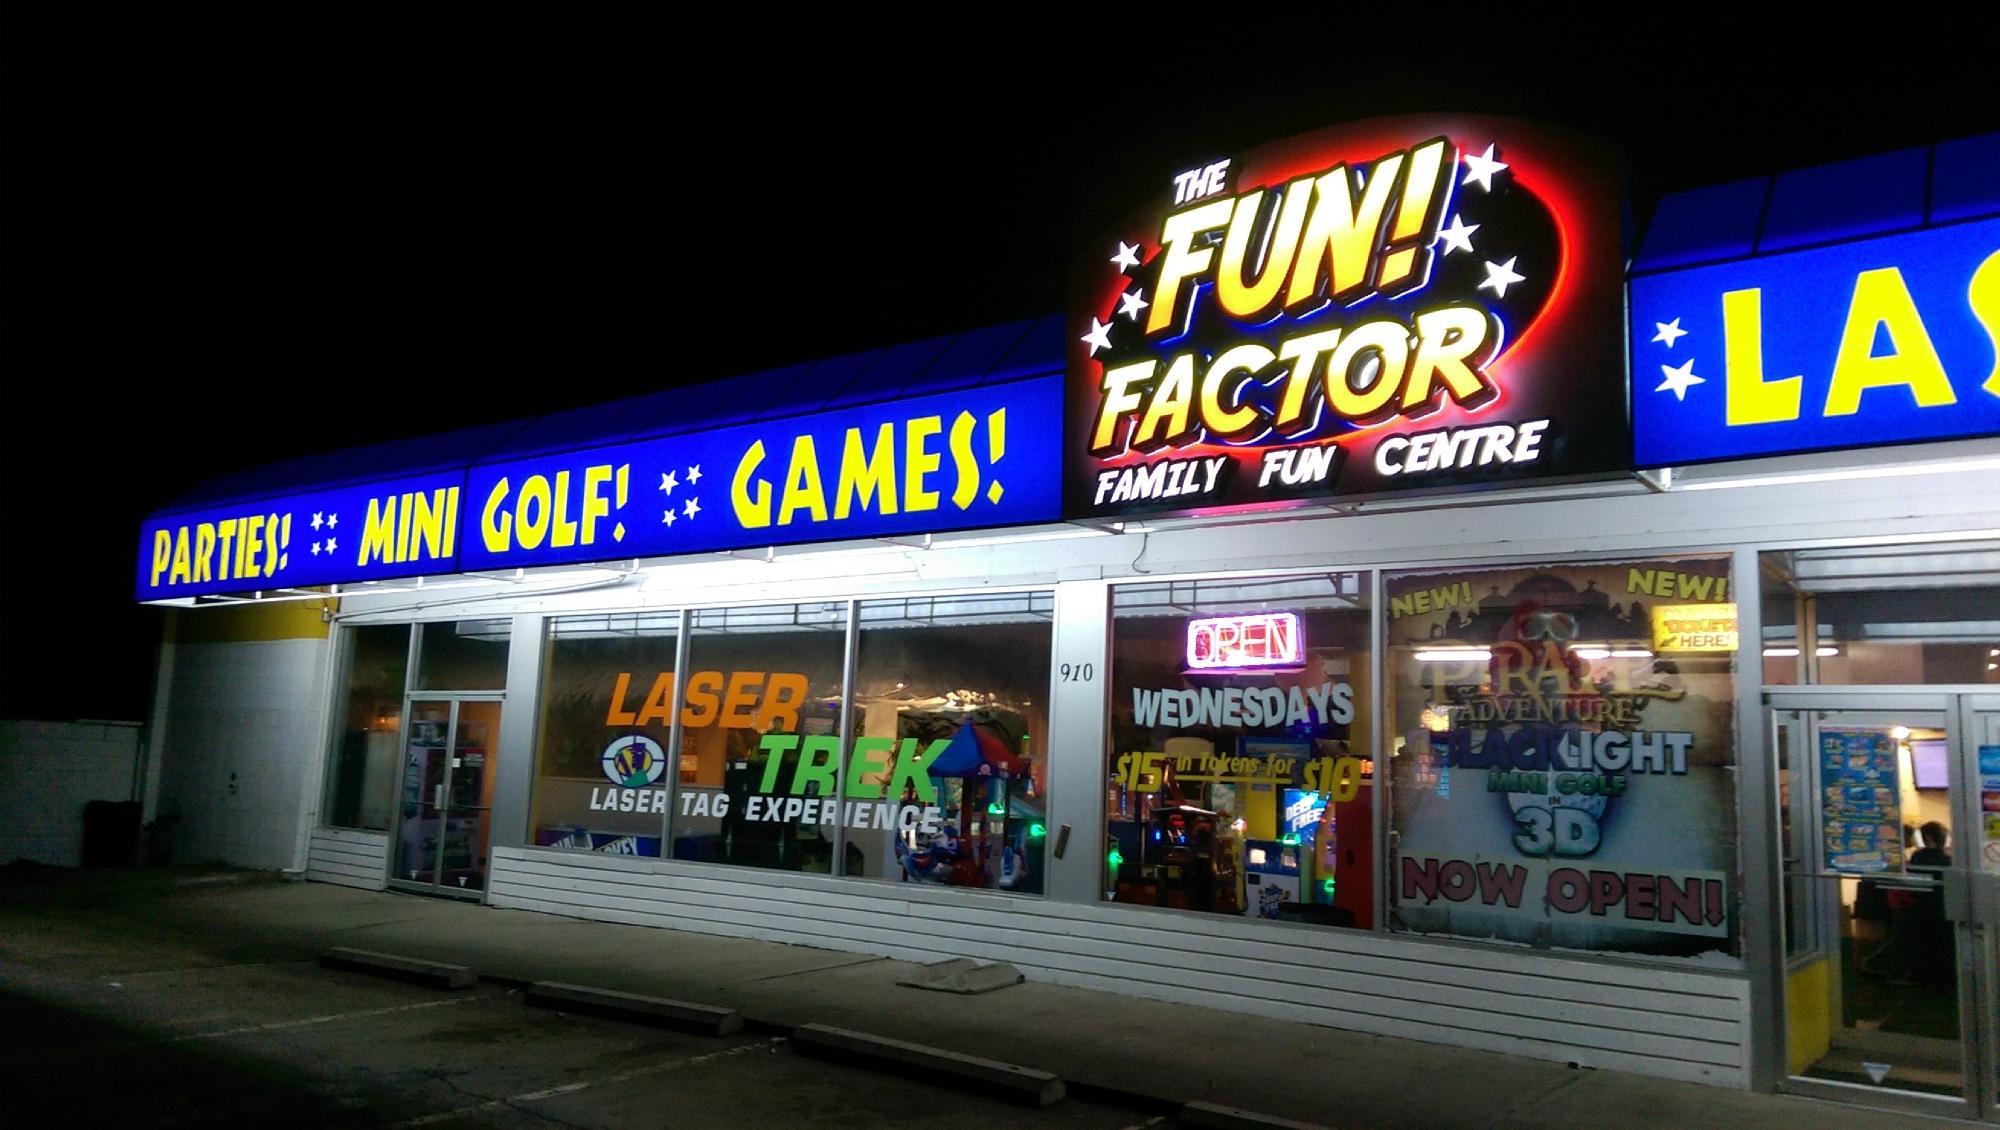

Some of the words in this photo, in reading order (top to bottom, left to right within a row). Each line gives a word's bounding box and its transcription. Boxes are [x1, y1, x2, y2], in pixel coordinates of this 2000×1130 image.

[1174, 158, 1231, 205] THE
[1144, 139, 1450, 336] FUN!
[1090, 306, 1492, 452] FACTOR
[1093, 456, 1228, 506] FAMILY
[1257, 445, 1337, 488] FUN
[1374, 419, 1550, 477] CENTRE
[150, 512, 293, 587] PARTIES!
[357, 486, 460, 567] MINI
[480, 463, 630, 554] GOLF!
[730, 406, 1006, 529] GAMES!
[1391, 581, 1473, 620] NEW!
[1627, 568, 1728, 602] NEW!
[1189, 616, 1297, 666] OPEN
[1060, 662, 1093, 682] 910
[605, 670, 809, 732] LASER
[1132, 682, 1355, 729] WEDNESDAYS
[1456, 698, 1643, 725] ADVENTURE
[758, 734, 953, 802] TREK
[1115, 751, 1166, 793] $15
[1266, 752, 1296, 775] for
[1302, 755, 1362, 803] $10
[1487, 771, 1548, 794] MINI
[1556, 772, 1628, 797] GOLF
[589, 787, 667, 814] LASER
[681, 791, 730, 818] TAG
[745, 796, 942, 834] EXPERIENCE
[1512, 805, 1601, 858] 3D
[1402, 856, 1528, 909] NOW
[1546, 866, 1725, 928] OPEN!
